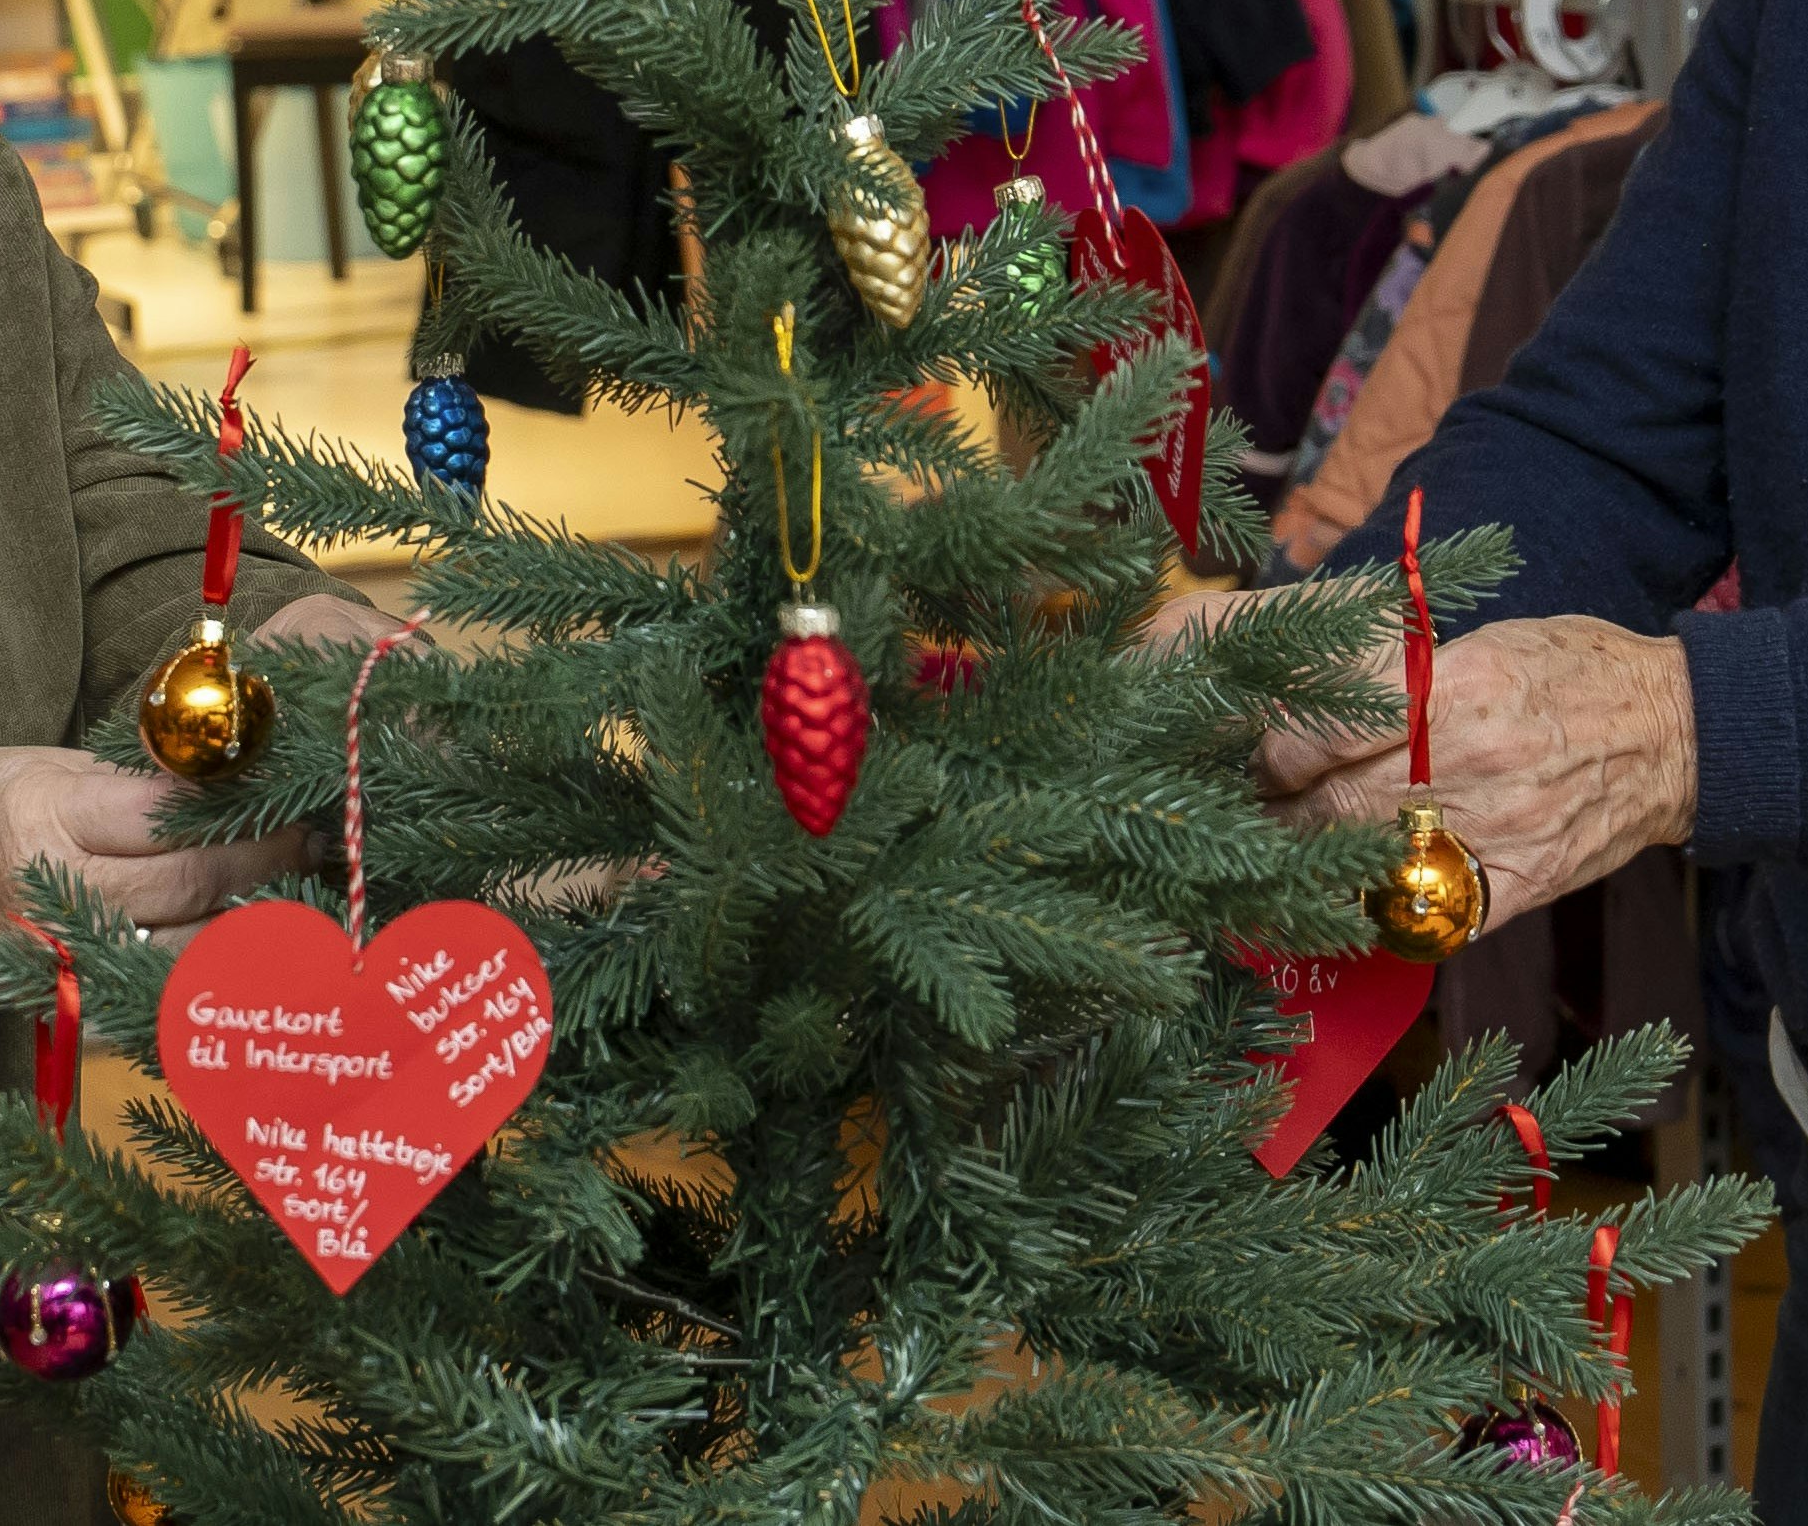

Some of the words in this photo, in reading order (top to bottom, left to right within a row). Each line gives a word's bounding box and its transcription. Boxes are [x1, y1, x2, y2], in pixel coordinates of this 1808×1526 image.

[385, 949, 455, 1005] Nike
[406, 948, 508, 1034] bukser
[483, 976, 536, 1022] 164
[186, 991, 343, 1037] Gavekort
[186, 1034, 230, 1070] til
[245, 1038, 394, 1087] Intersport
[245, 1115, 308, 1152] Nike
[311, 1162, 367, 1199] 164
[316, 1225, 373, 1261] Blå
